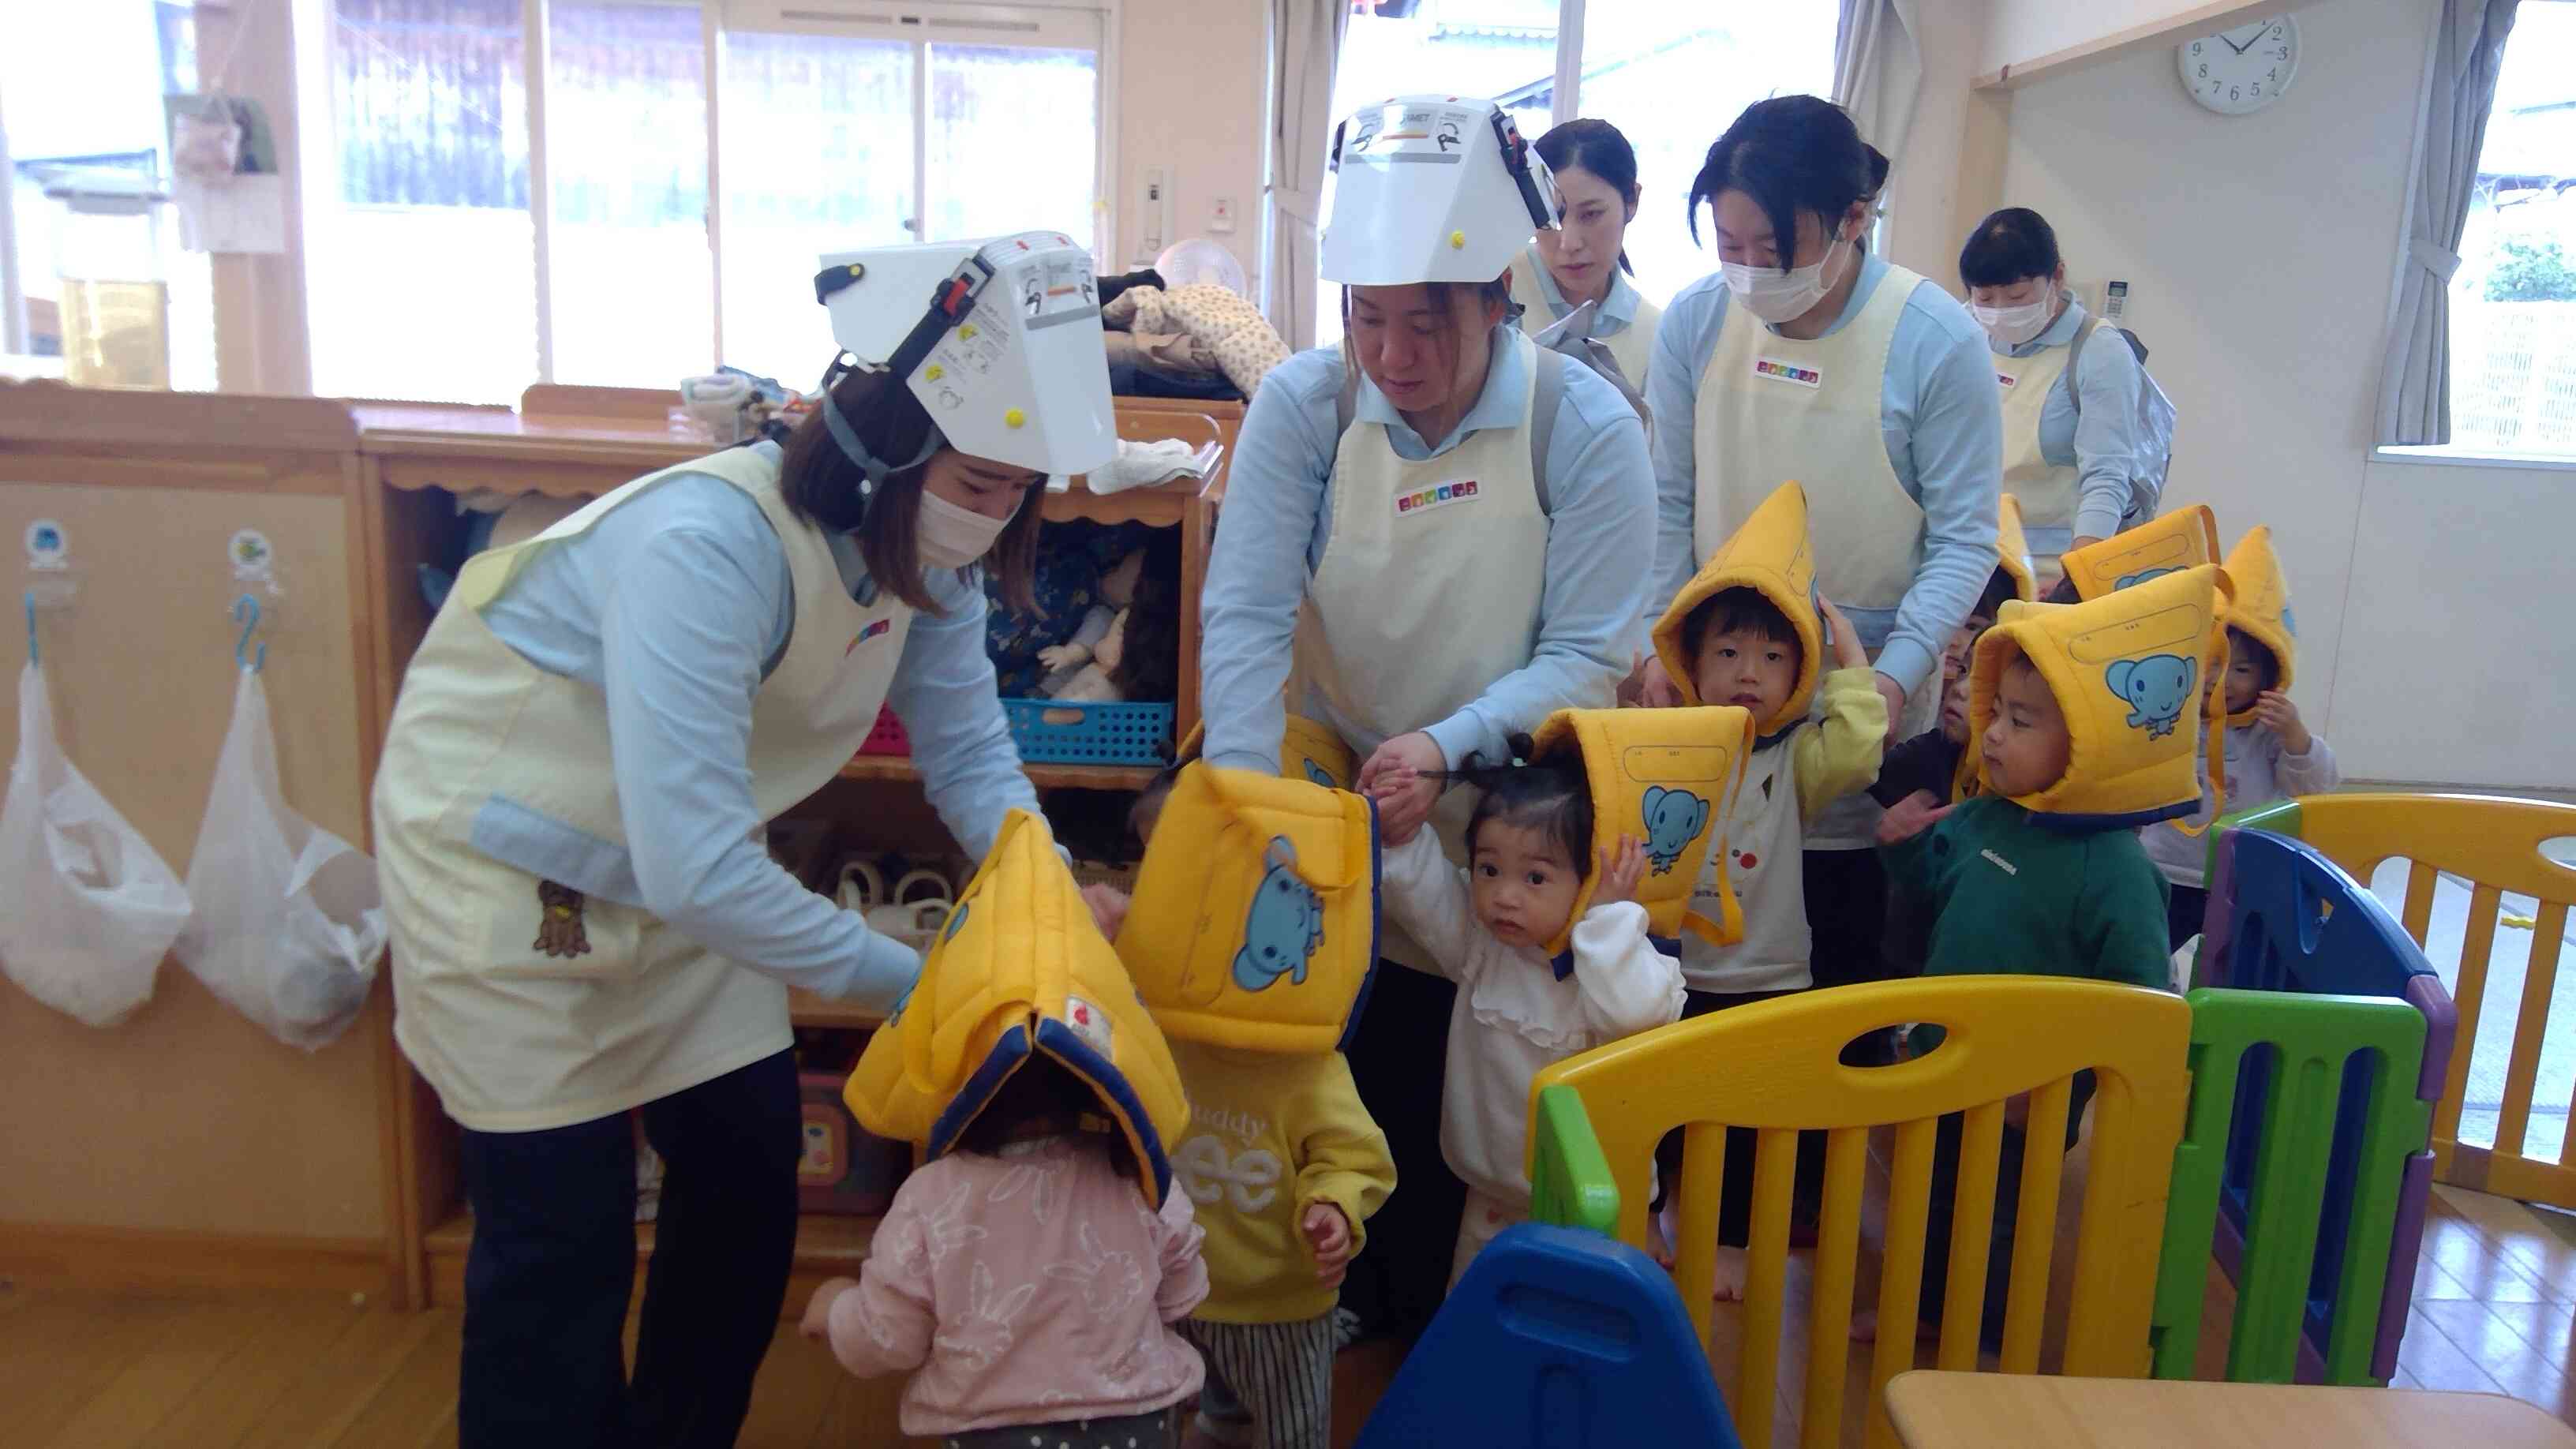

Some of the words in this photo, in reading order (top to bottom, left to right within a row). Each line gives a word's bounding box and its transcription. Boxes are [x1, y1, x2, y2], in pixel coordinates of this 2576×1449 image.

[2272, 26, 2282, 41] 2
[2192, 42, 2201, 56] 9
[2277, 47, 2288, 61] 3
[2198, 63, 2207, 78] 8
[2267, 67, 2276, 81] 4
[2213, 80, 2222, 94] 7
[2230, 85, 2240, 101] 6
[2250, 82, 2260, 96] 5
[1190, 1103, 1267, 1148] uddy
[1170, 1135, 1282, 1212] ee
